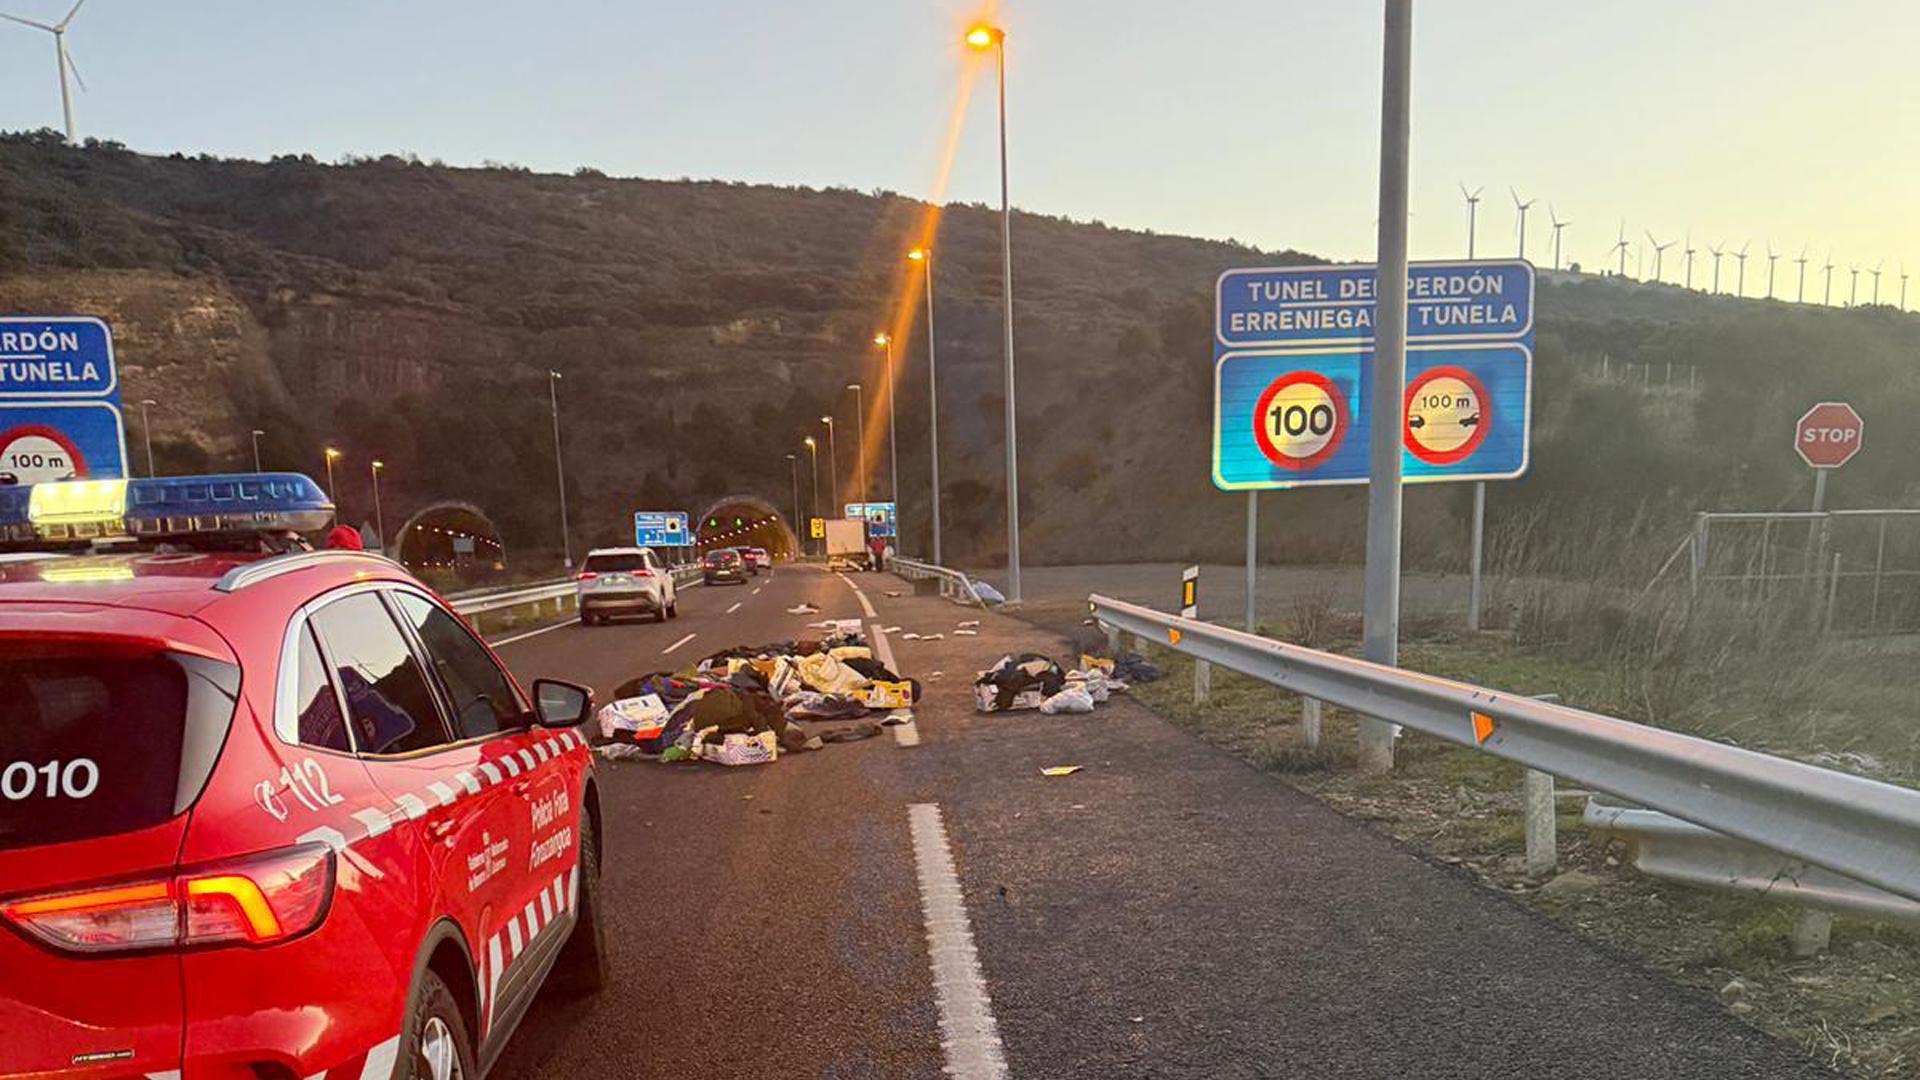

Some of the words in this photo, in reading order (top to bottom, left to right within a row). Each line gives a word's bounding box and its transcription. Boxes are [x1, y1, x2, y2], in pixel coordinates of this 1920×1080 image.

[1248, 280, 1328, 301] TUNEL
[1230, 308, 1376, 332] ERRENIEGA
[1419, 304, 1517, 326] TUNELA
[0, 327, 79, 351] RDÓN
[1422, 395, 1451, 409] 100
[1456, 397, 1471, 409] m
[1270, 404, 1333, 436] 100
[1804, 427, 1857, 443] STOP
[11, 454, 43, 468] 100
[49, 456, 64, 467] m
[1, 758, 99, 800] 010
[280, 757, 345, 812] 112
